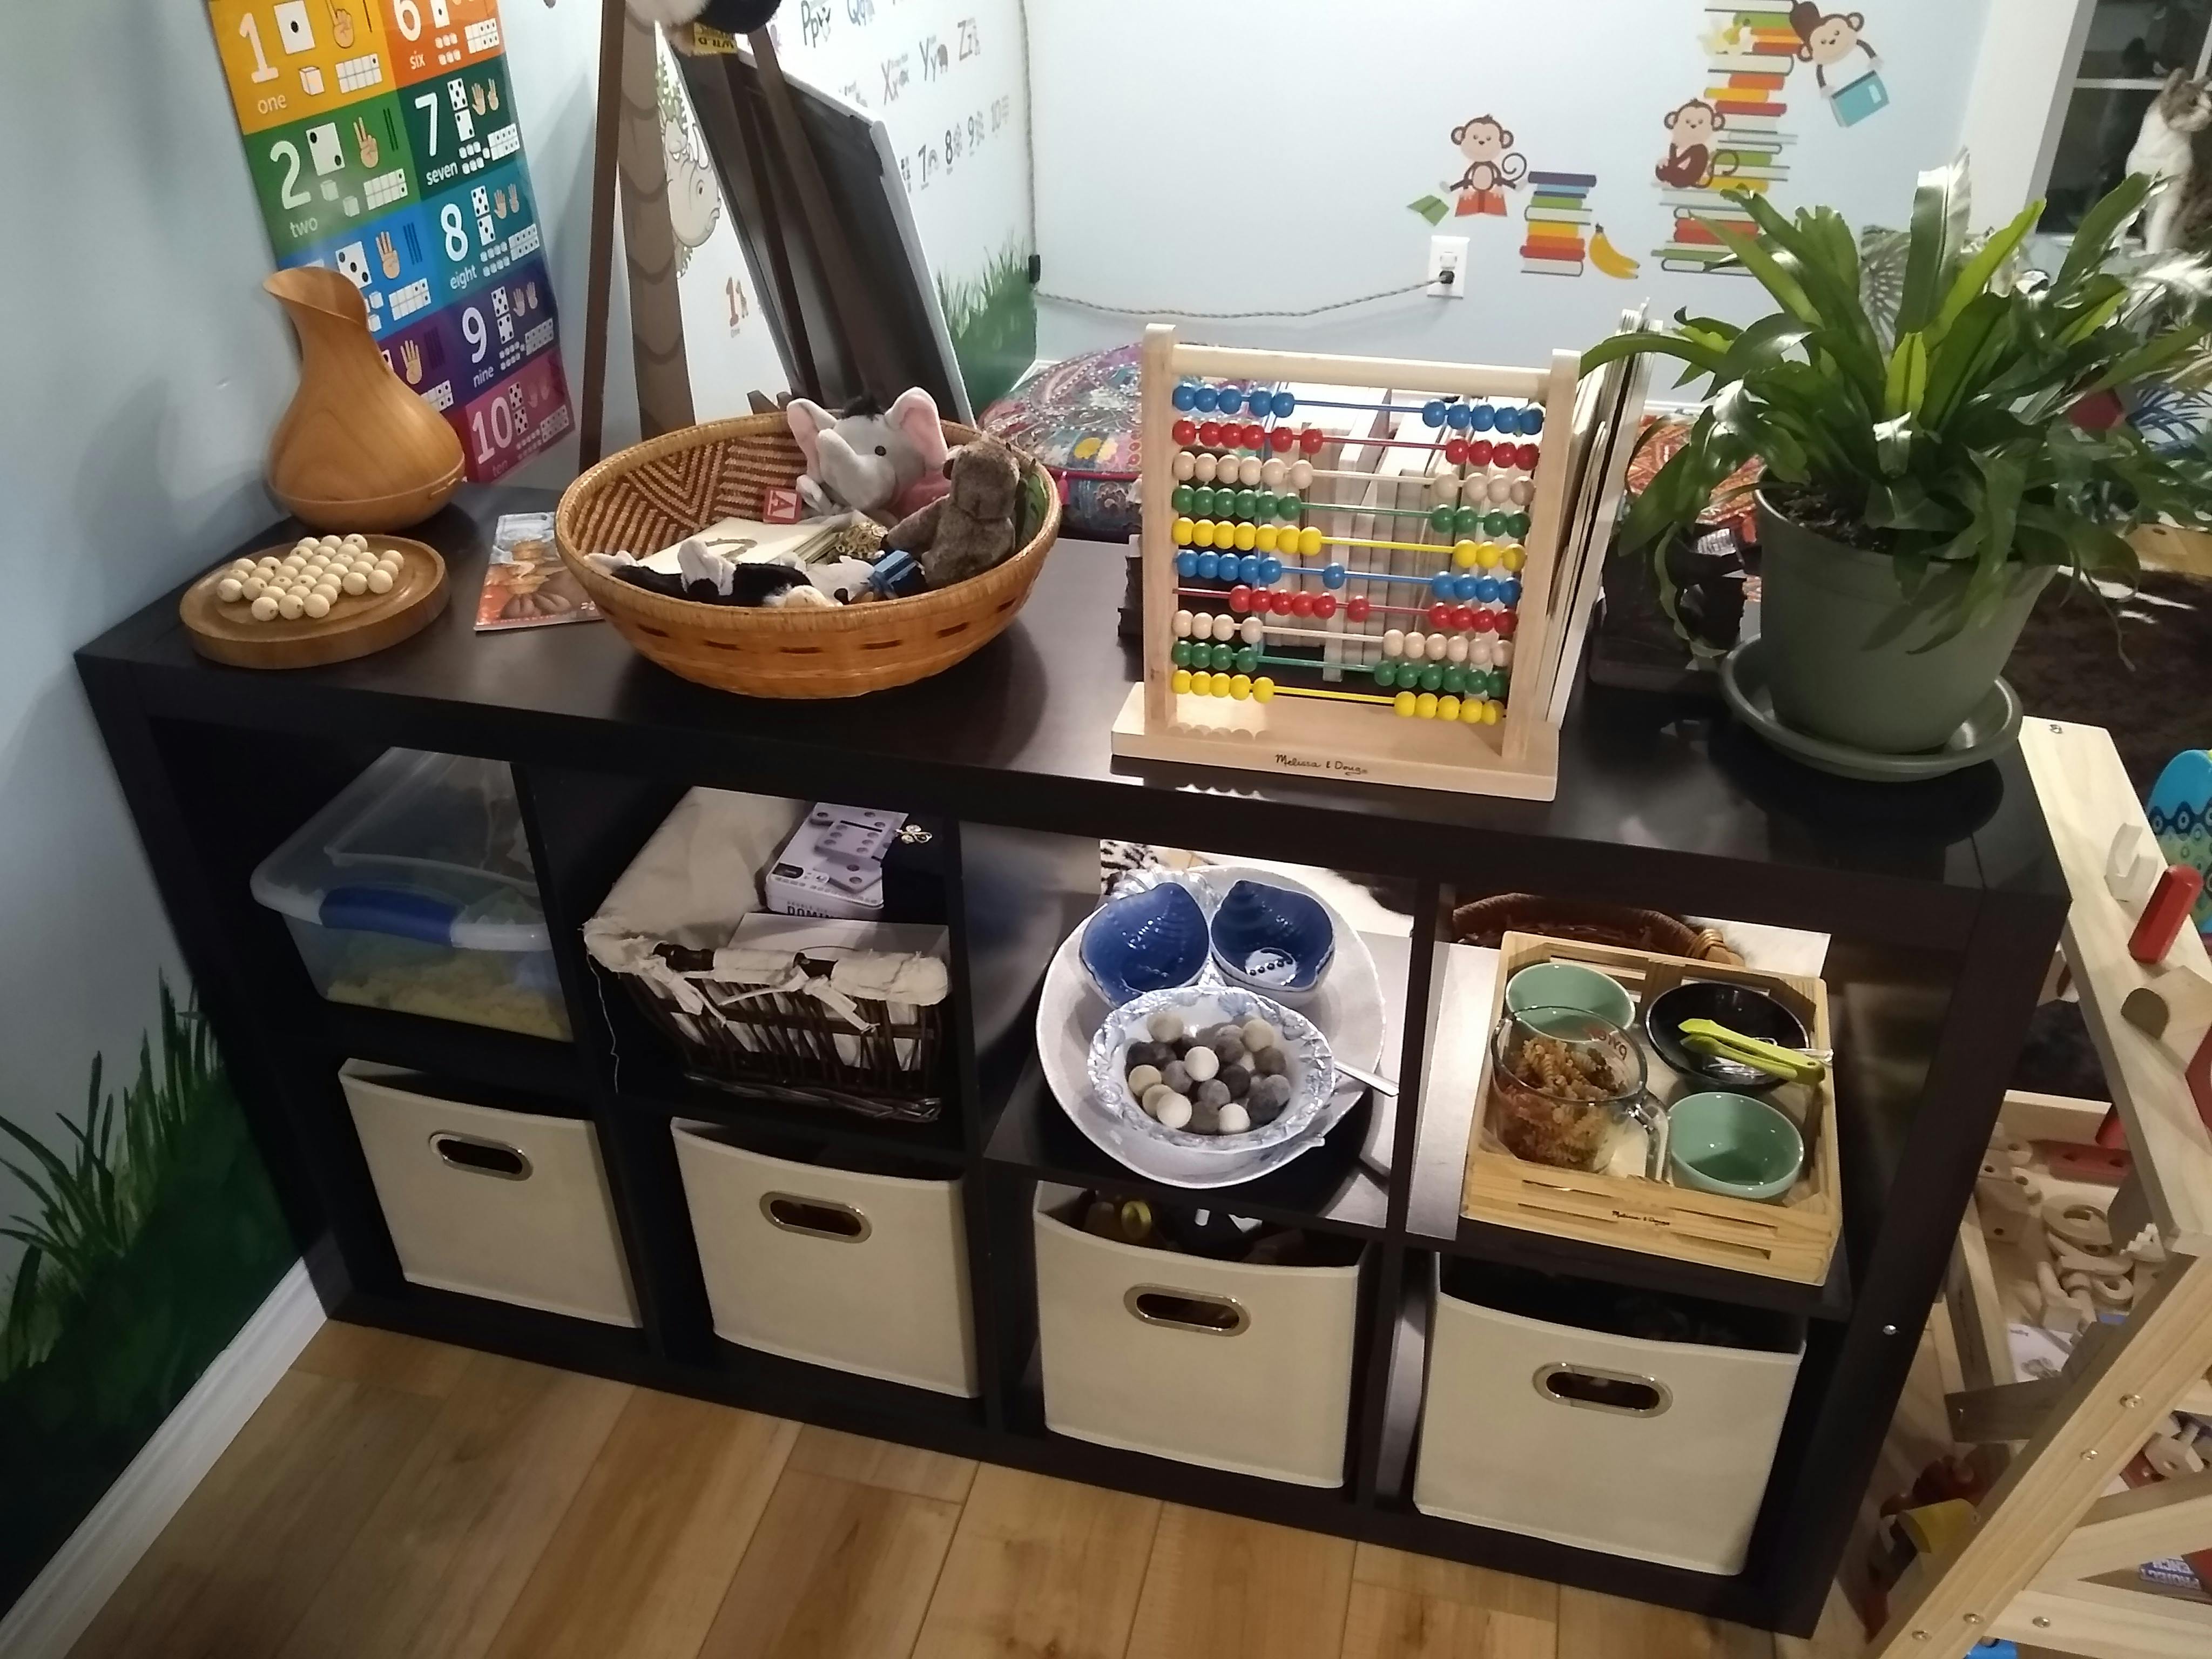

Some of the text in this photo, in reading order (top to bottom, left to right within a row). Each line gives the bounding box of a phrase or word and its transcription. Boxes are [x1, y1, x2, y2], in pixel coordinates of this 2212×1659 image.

[393, 0, 422, 42] 6
[800, 0, 819, 48] Pp
[239, 12, 279, 84] 1
[409, 50, 426, 70] six
[919, 37, 937, 82] Yy
[257, 95, 288, 114] one
[880, 58, 899, 106] Xx
[415, 92, 438, 157] 7
[945, 129, 953, 165] 8
[968, 116, 974, 147] 9
[270, 140, 312, 210] 2
[426, 162, 458, 186] seven
[289, 217, 318, 238] two
[440, 203, 469, 262] 8
[450, 264, 478, 289] eight
[462, 307, 487, 363] 9
[473, 366, 494, 388] nine
[472, 396, 512, 464] 10
[770, 491, 794, 515] A
[1275, 754, 1321, 768] Melissa
